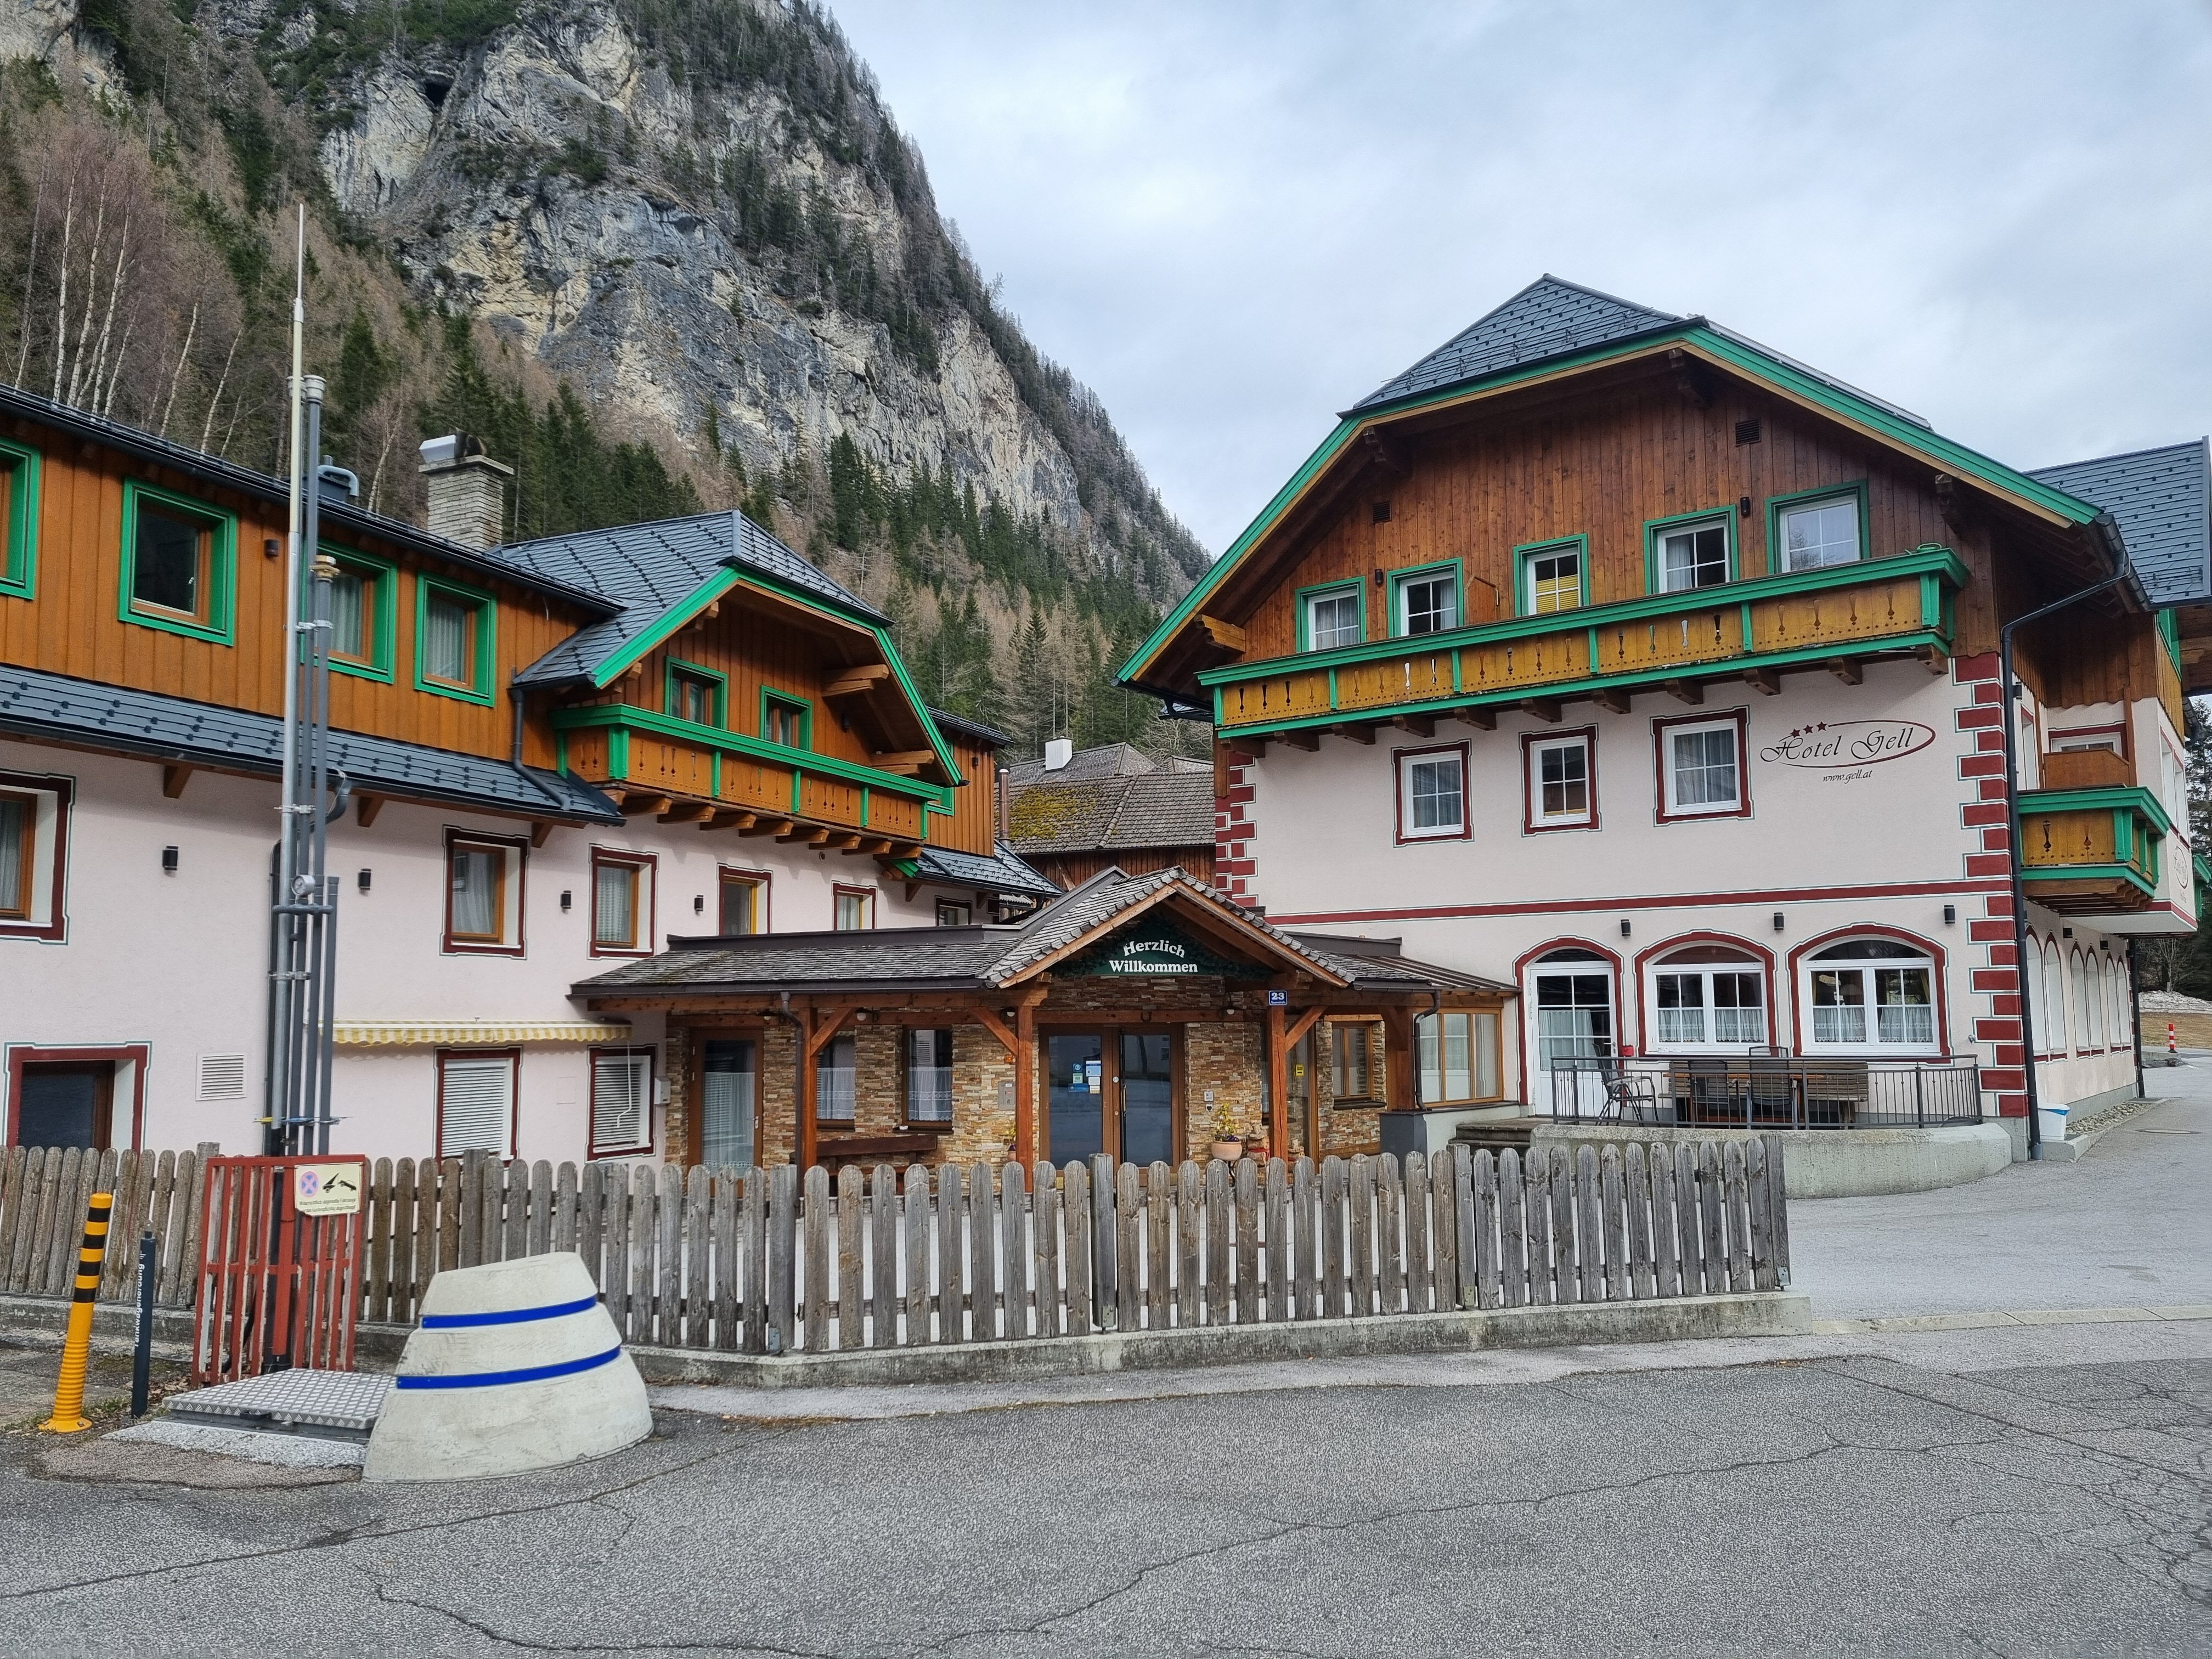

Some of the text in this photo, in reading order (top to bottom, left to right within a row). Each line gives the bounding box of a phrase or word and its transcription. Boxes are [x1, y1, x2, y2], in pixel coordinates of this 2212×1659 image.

[1760, 727, 1914, 762] Hotel Gell
[1822, 769, 1873, 784] www.gell.at
[1123, 939, 1186, 958] Herzlich
[1108, 960, 1198, 973] Willkommen
[1271, 992, 1285, 1000] 23
